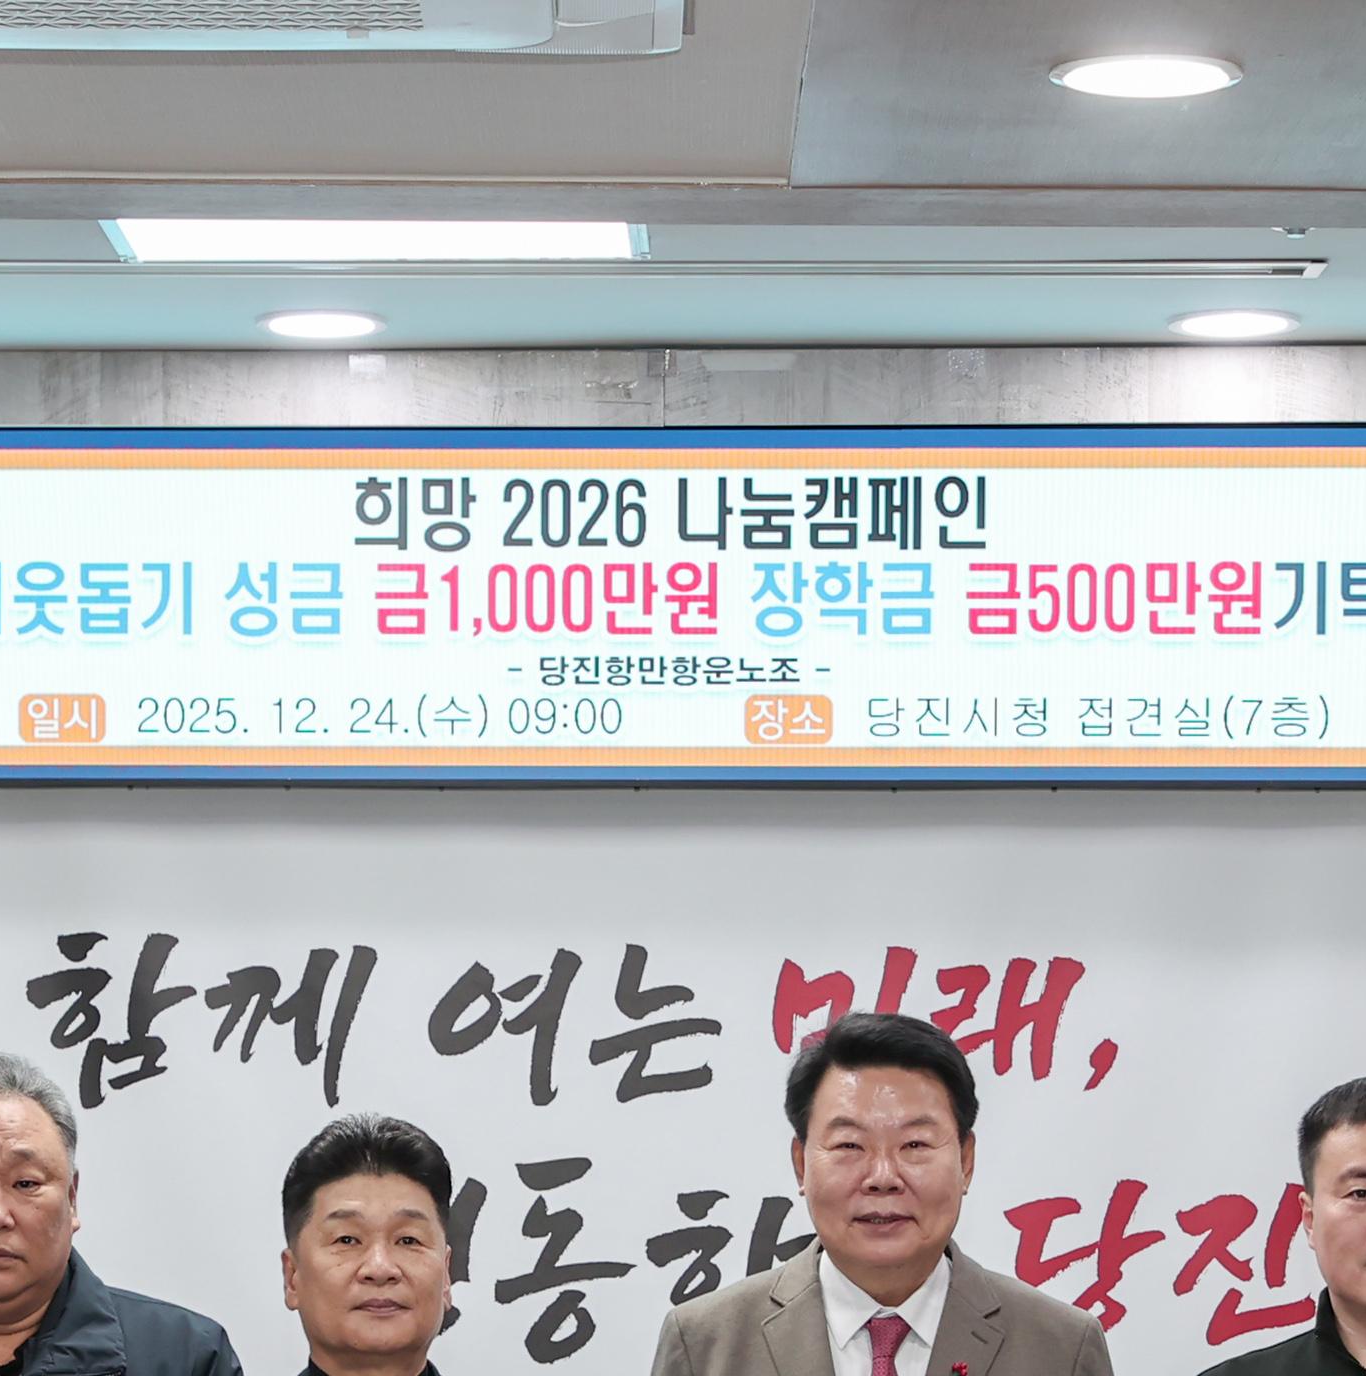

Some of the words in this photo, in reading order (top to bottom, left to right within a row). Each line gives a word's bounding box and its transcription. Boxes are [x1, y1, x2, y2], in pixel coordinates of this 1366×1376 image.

[354, 477, 477, 552] 희망
[503, 479, 647, 549] 2026
[678, 475, 987, 551] 나눔캠페인
[225, 562, 344, 637] 성금
[375, 562, 718, 637] 금1,000만원
[751, 561, 935, 637] 장학금
[26, 697, 99, 740] 일시
[137, 697, 248, 735] 2025.
[273, 698, 330, 735] 12.
[350, 693, 488, 739] 24.(수)
[509, 698, 622, 735] 09:00
[750, 699, 827, 741] 장소
[868, 697, 1048, 738] 당진시청
[1078, 695, 1330, 740] 접견실(7층)
[27, 933, 378, 1108] 함께
[428, 943, 722, 1106] 여는
